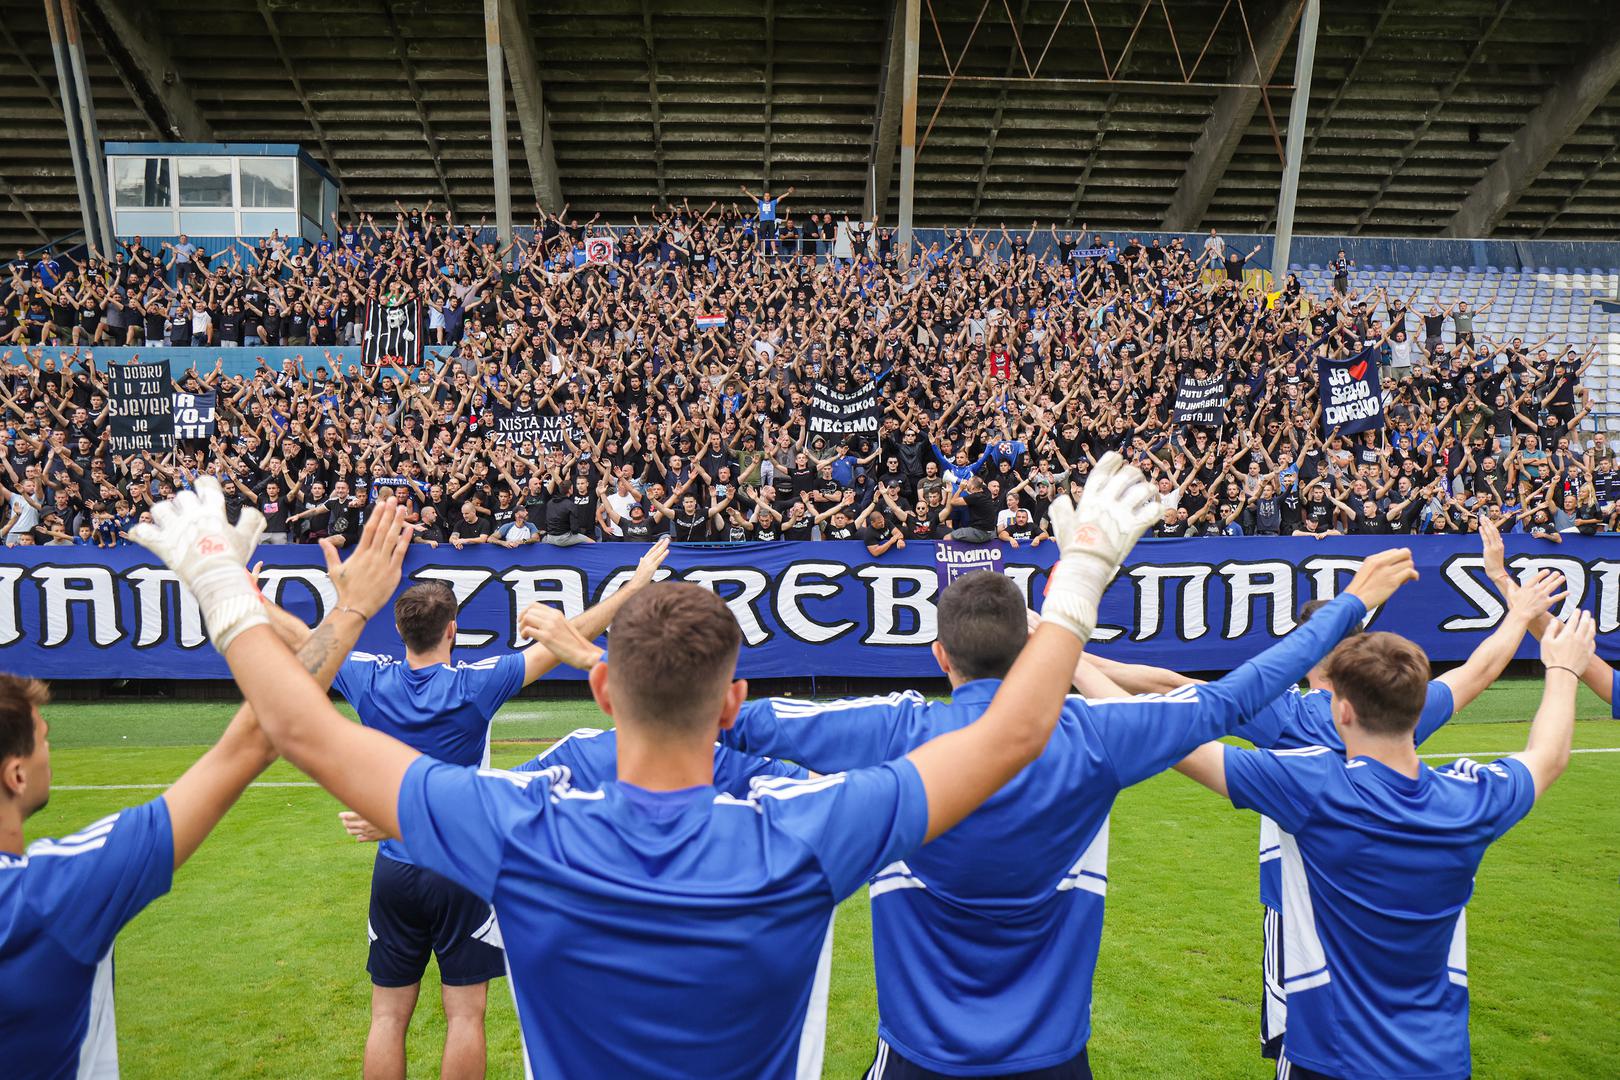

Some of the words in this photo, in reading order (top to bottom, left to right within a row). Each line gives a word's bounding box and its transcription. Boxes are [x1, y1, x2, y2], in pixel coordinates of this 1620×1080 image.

[109, 366, 116, 379] U
[123, 365, 162, 379] DOBRU
[1328, 368, 1351, 386] JA
[113, 382, 117, 395] I
[124, 382, 132, 395] U
[140, 381, 160, 395] ZLU
[1180, 389, 1202, 398] PUTU
[1331, 380, 1370, 405] SAMO
[813, 397, 840, 414] PRED
[1325, 396, 1380, 425] DINAMO
[499, 416, 540, 430] NIŠTA
[543, 414, 573, 429] NAS
[810, 416, 878, 433] NEĆEMO
[1180, 412, 1214, 422] OSTAJU
[936, 543, 1002, 562] dinamo
